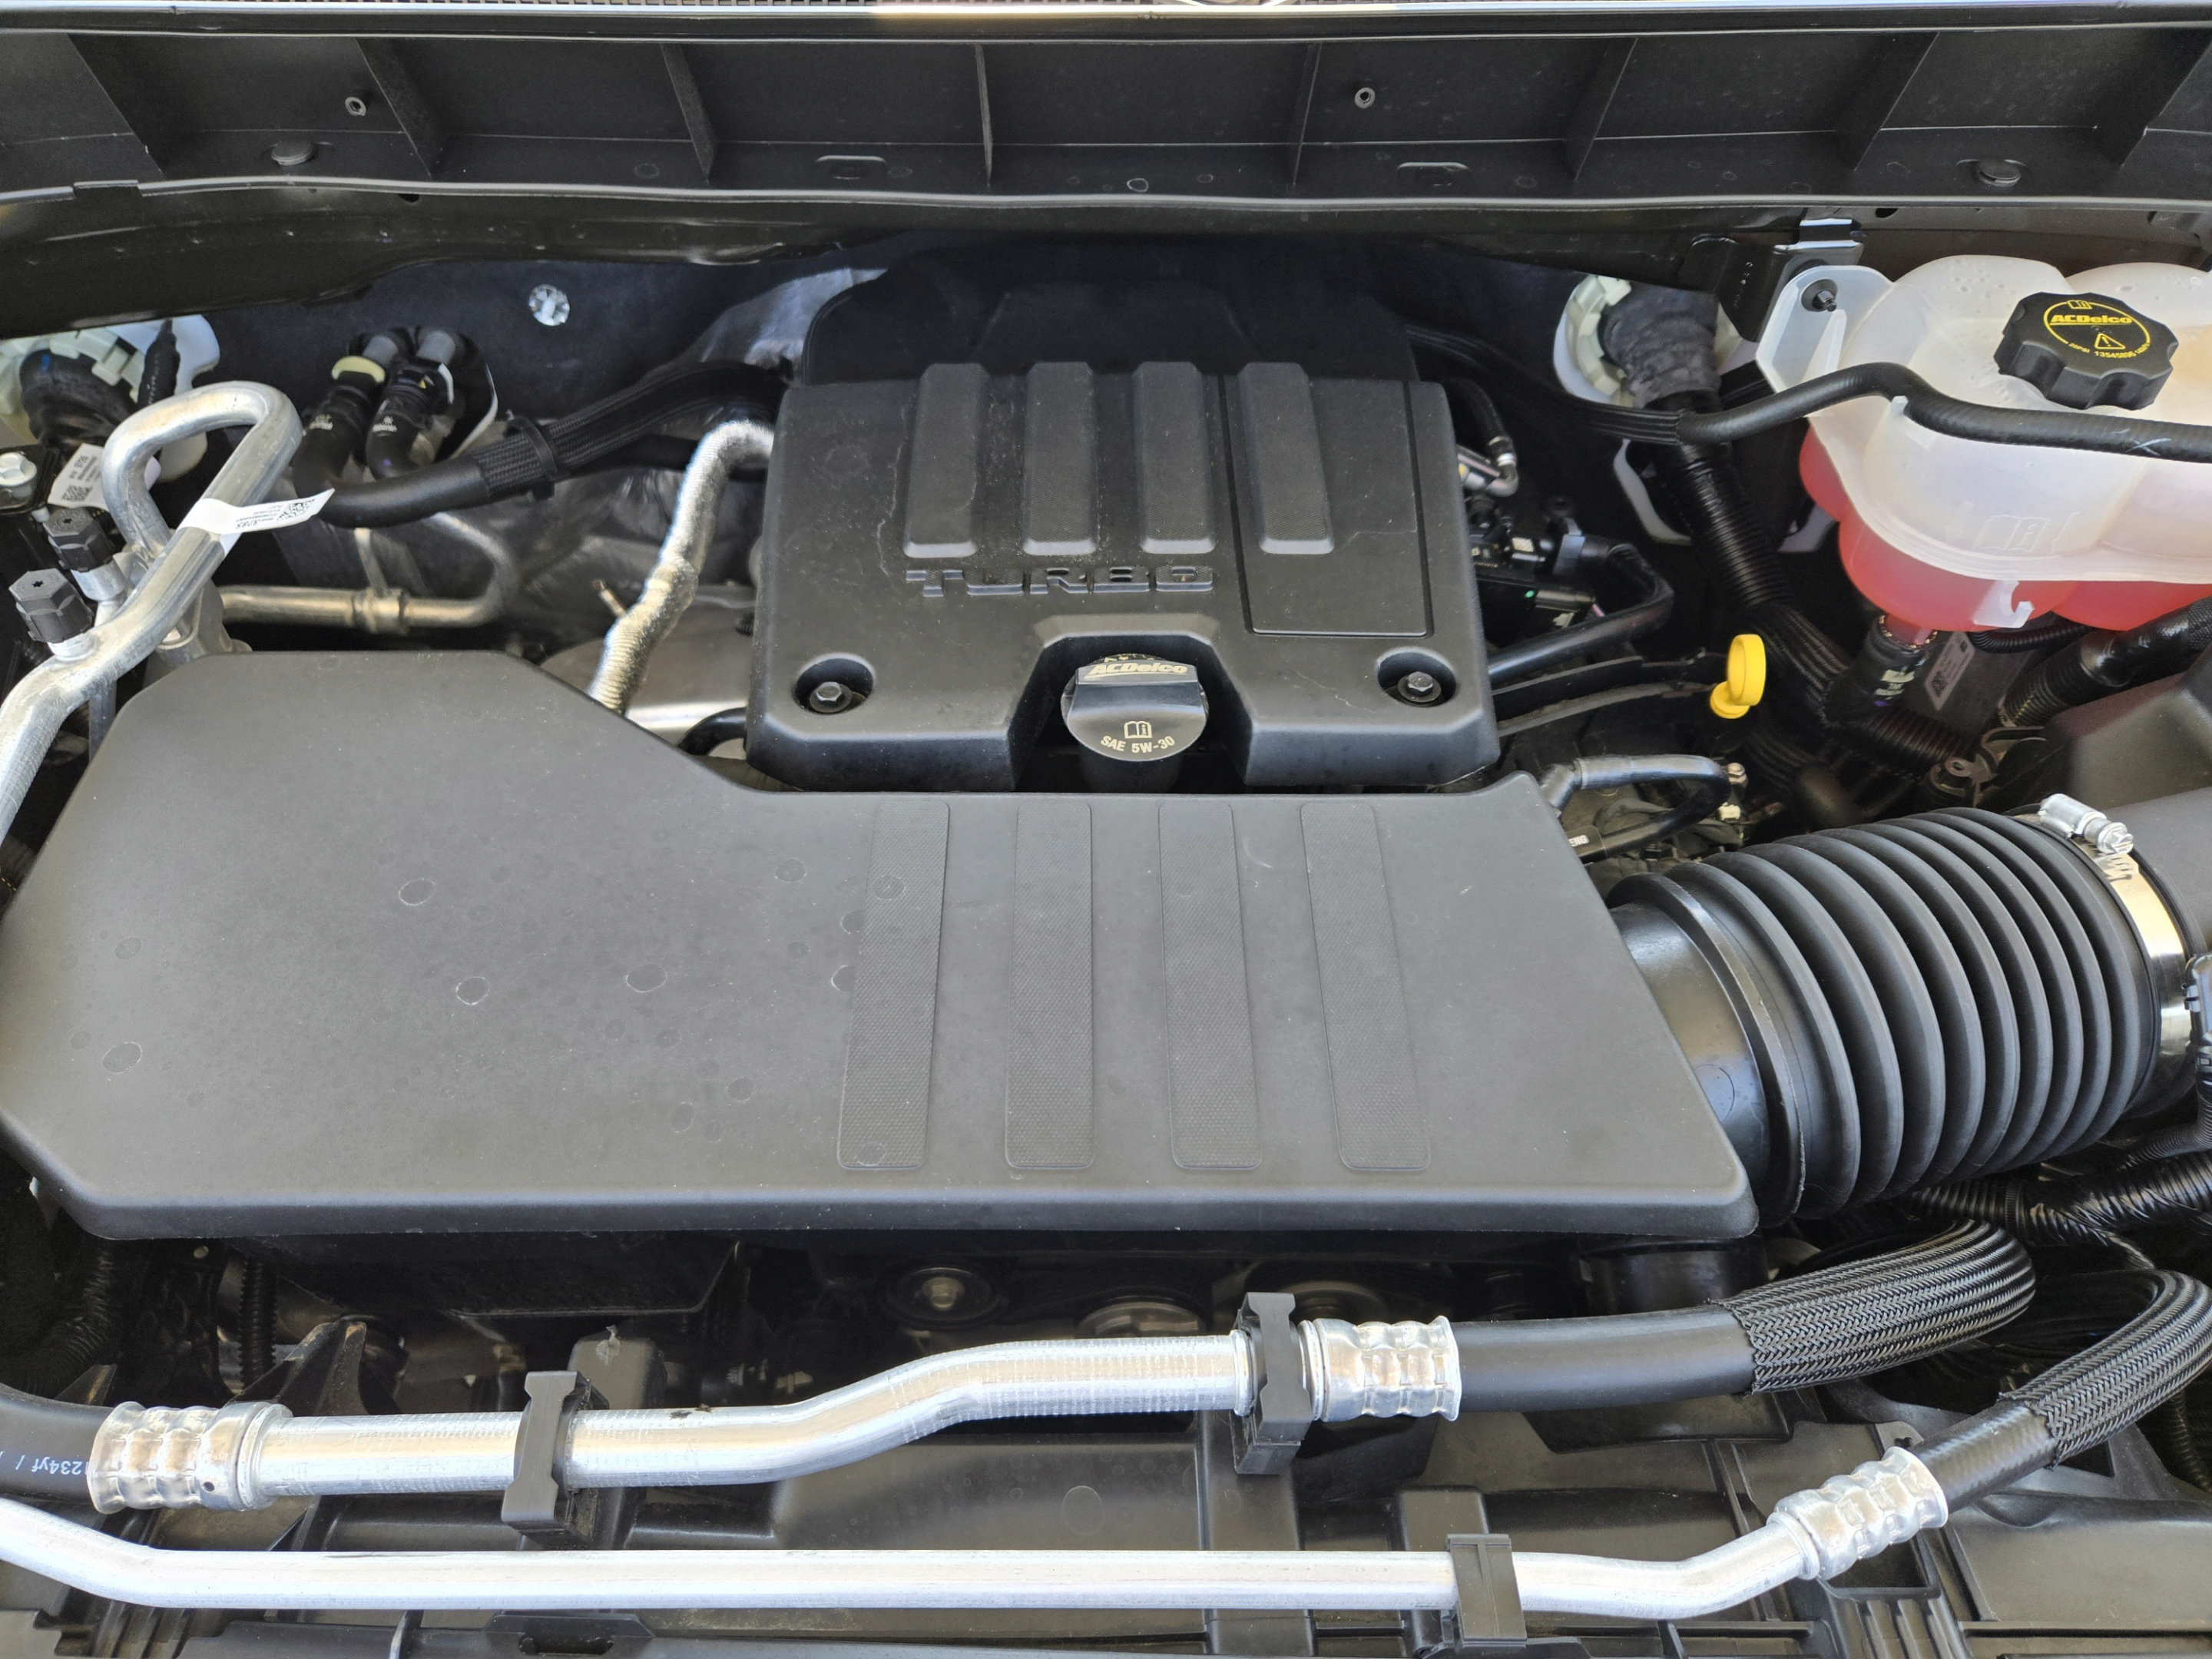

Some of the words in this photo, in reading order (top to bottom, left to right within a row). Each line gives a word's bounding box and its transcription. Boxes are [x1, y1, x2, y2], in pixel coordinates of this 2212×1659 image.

[2051, 315, 2132, 323] ACDelco
[906, 566, 1214, 598] TURBO
[1088, 662, 1188, 676] ACDelco
[1101, 735, 1126, 751] SAE
[1131, 735, 1175, 753] 5W-30
